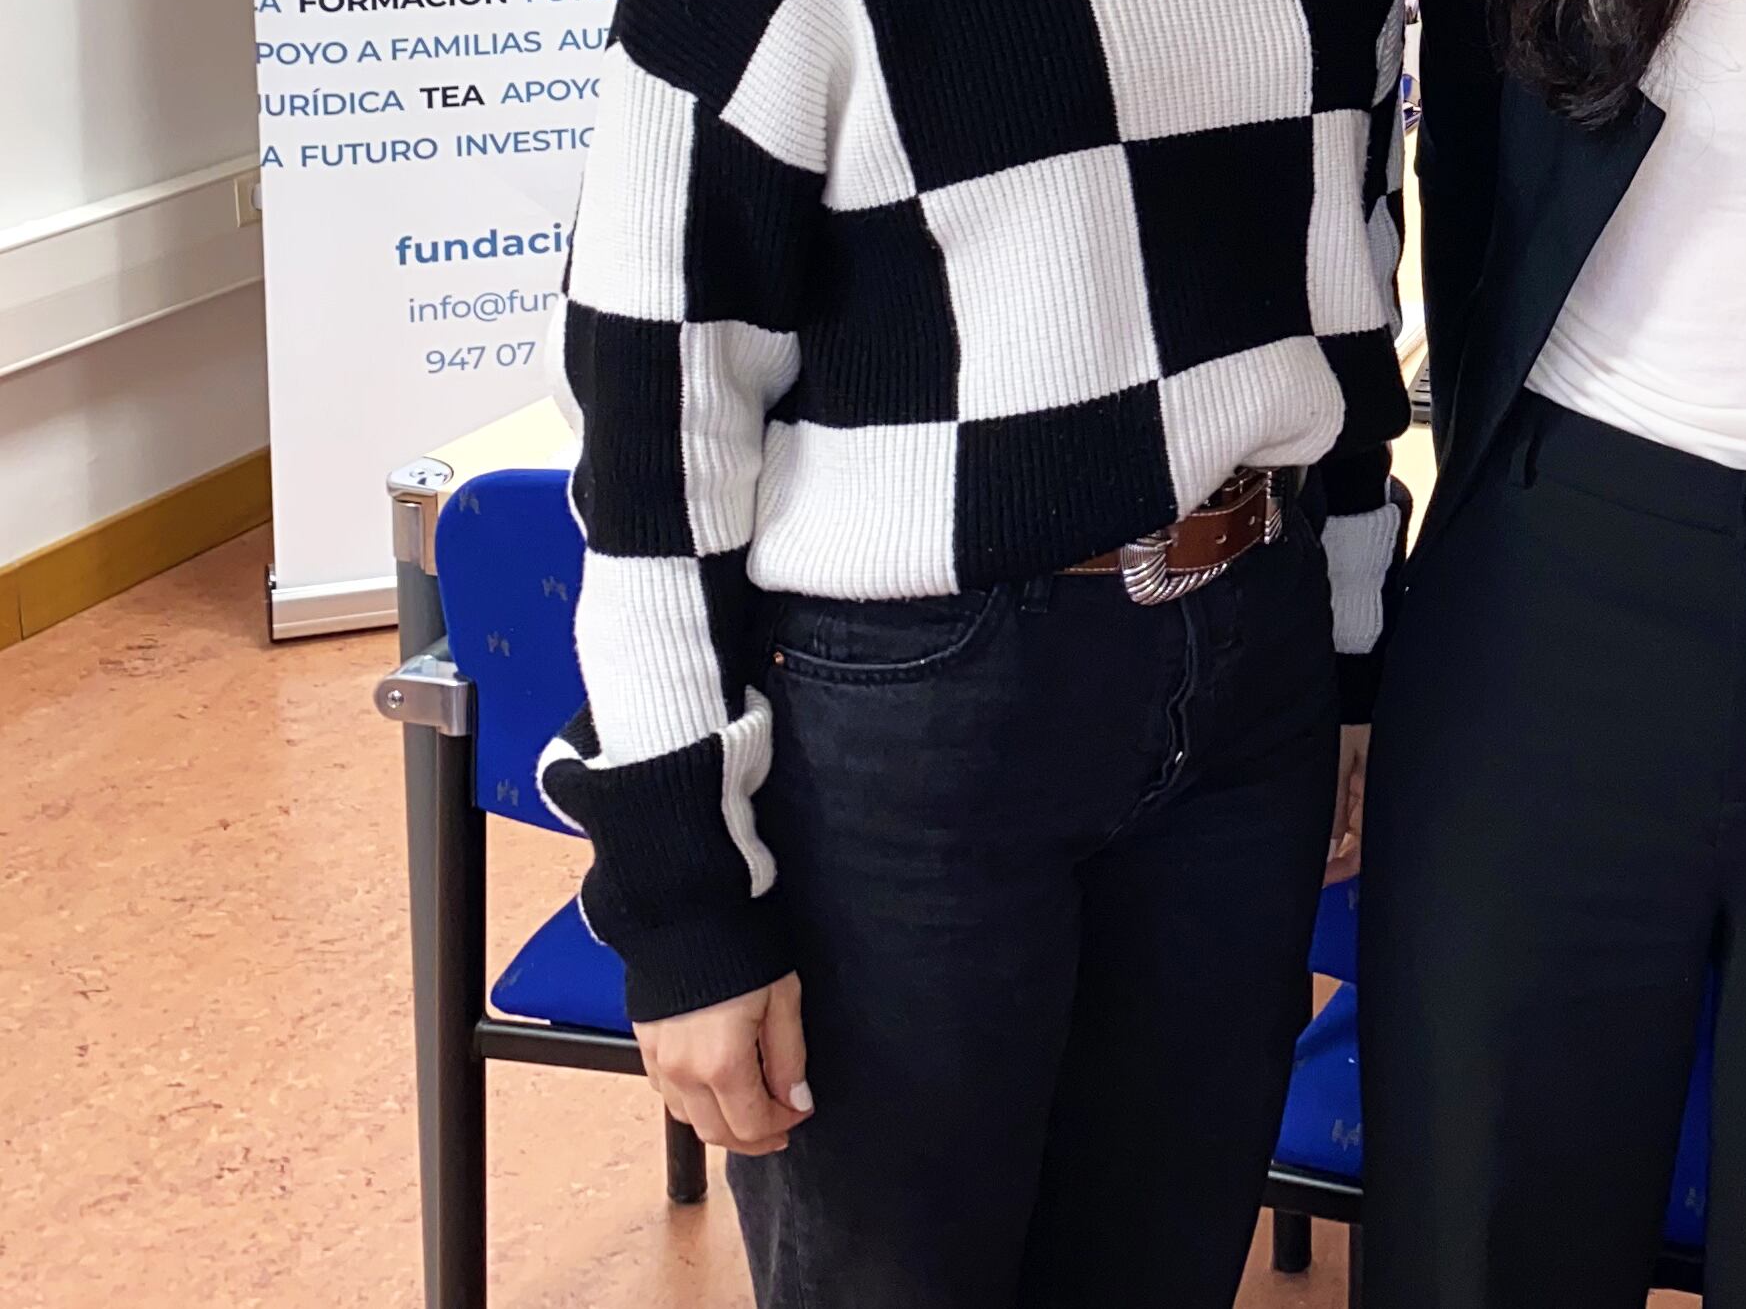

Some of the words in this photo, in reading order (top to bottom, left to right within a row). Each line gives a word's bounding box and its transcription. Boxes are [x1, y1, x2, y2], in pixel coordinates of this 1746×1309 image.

[255, 42, 348, 65] POYO
[357, 41, 382, 63] A
[392, 31, 542, 60] FAMILIAS
[559, 28, 609, 50] AU
[419, 85, 485, 109] TEA
[261, 146, 283, 167] A
[301, 138, 438, 167] FUTURO
[426, 346, 485, 374] 947
[496, 342, 536, 367] 07
